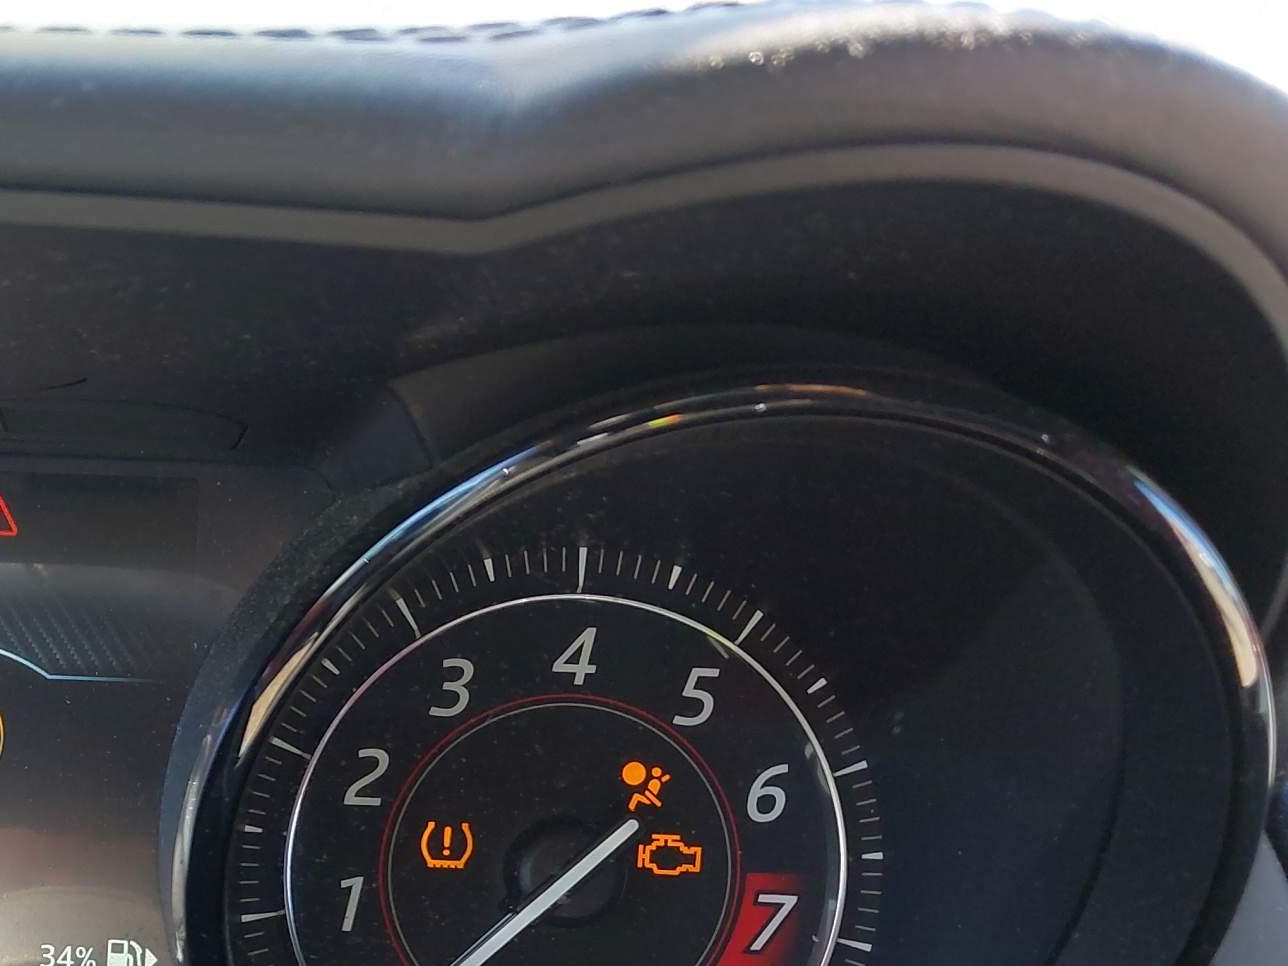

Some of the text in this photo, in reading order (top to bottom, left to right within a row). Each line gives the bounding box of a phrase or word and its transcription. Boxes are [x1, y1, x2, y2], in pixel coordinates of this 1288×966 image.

[552, 627, 597, 686] 4
[428, 658, 474, 717] 3
[672, 667, 719, 727] 5
[343, 748, 390, 807] 2
[746, 763, 789, 823] 6
[339, 876, 364, 932] 1
[748, 893, 798, 952] 7
